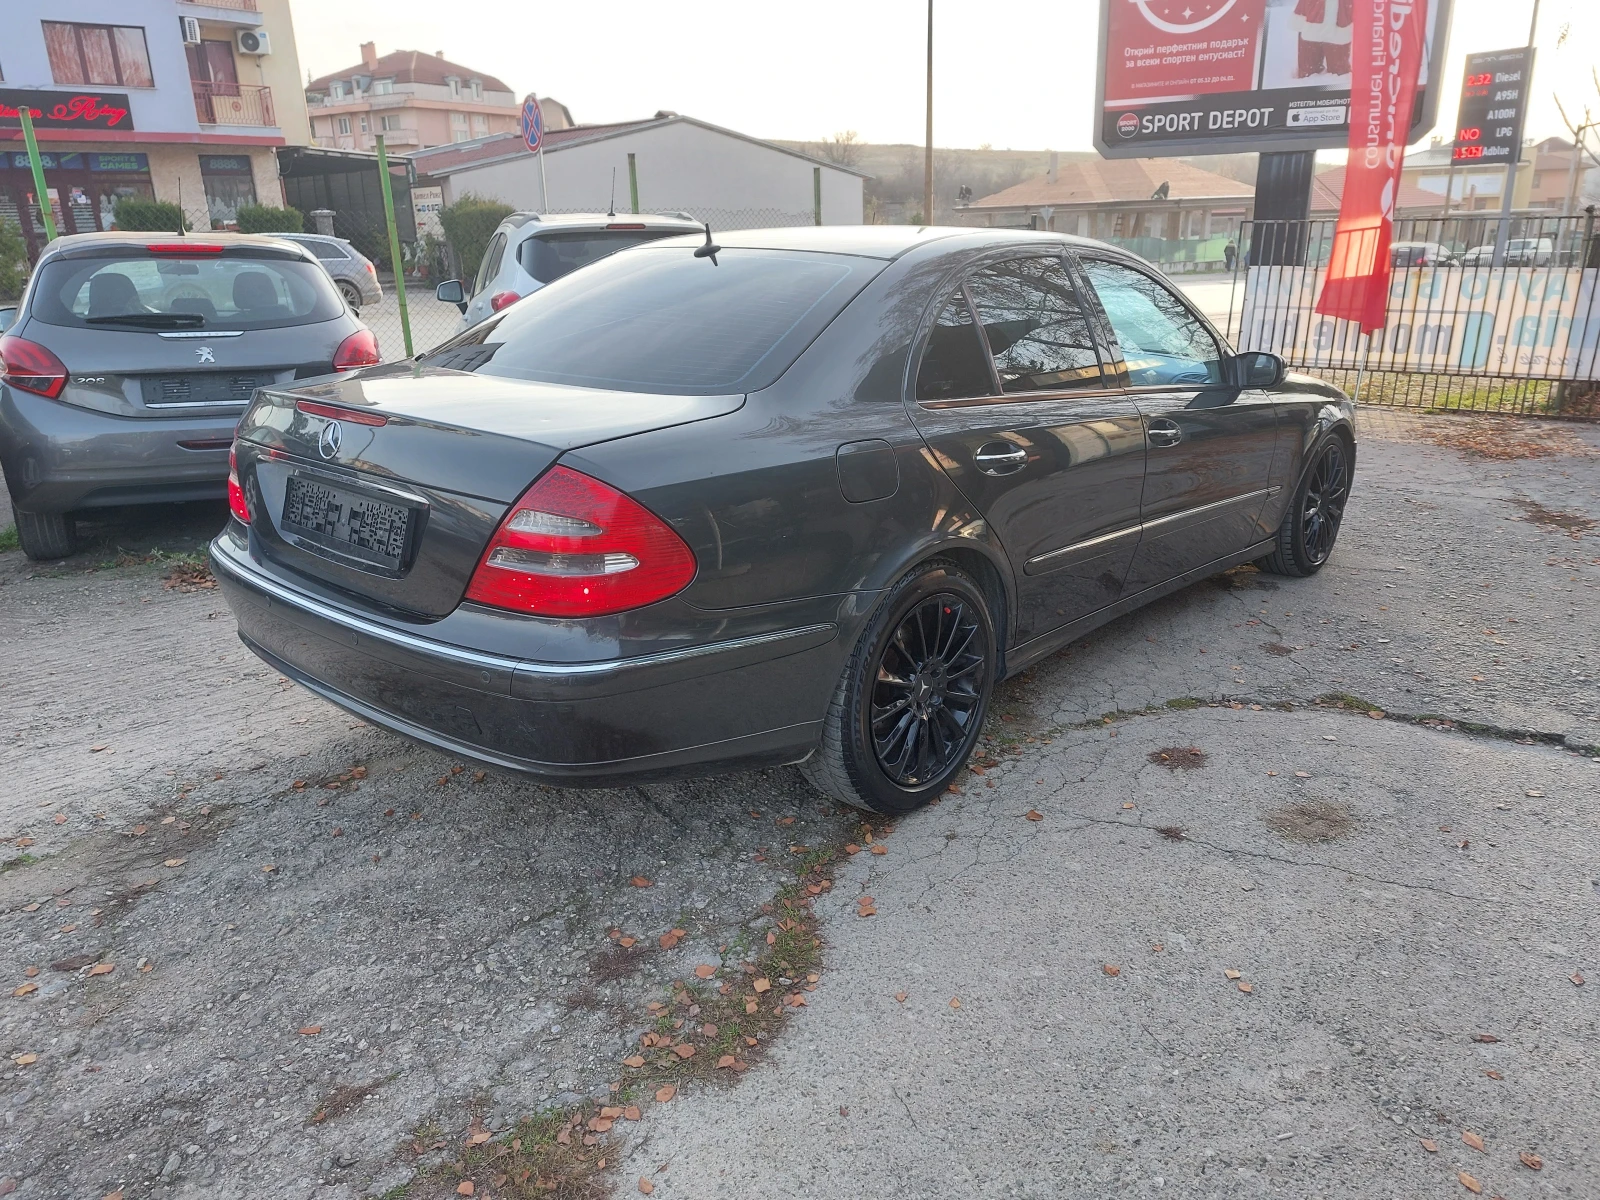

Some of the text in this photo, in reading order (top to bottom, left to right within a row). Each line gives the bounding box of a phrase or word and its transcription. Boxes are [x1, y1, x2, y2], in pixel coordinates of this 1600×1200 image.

[1124, 37, 1249, 57] Открий перфектния подарък
[1125, 47, 1245, 68] за всеки спортен ентусиаст!
[1495, 70, 1521, 83] Diesel
[1317, 98, 1351, 106] МОБИЛНОТ
[1141, 107, 1274, 134] SPORT DEPOT
[1303, 114, 1341, 123] App Store
[1460, 127, 1513, 140] NO LPG
[1482, 145, 1510, 156] Adblue
[77, 377, 106, 385] 208
